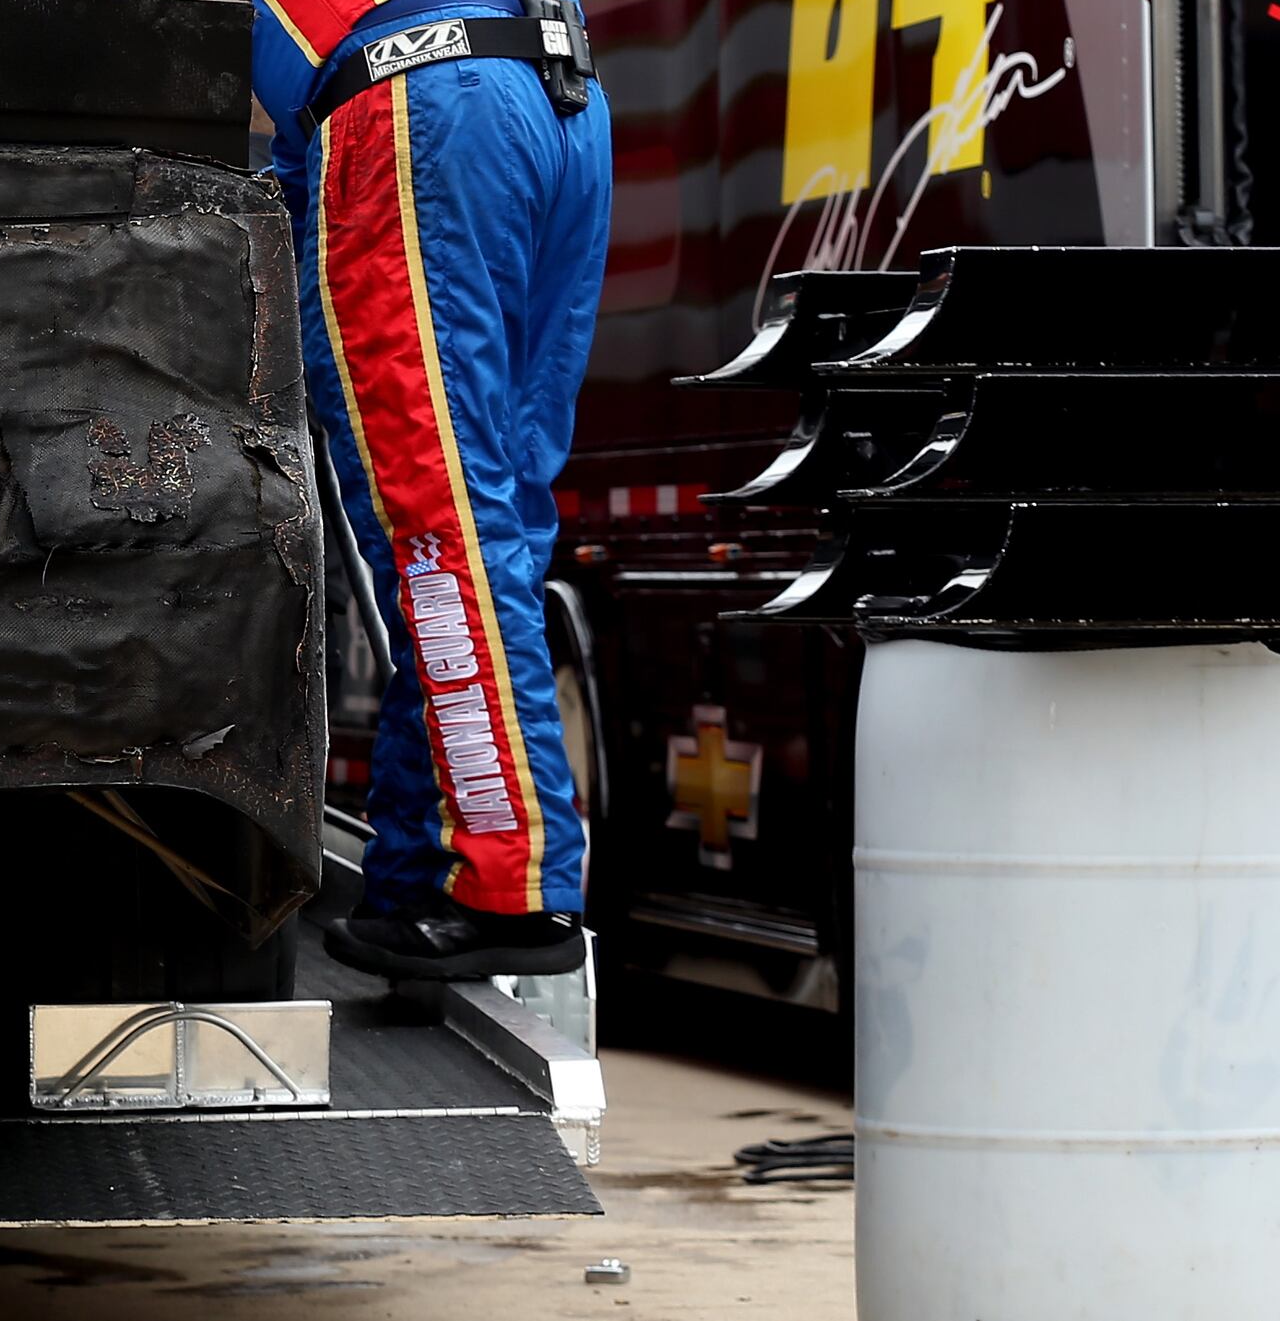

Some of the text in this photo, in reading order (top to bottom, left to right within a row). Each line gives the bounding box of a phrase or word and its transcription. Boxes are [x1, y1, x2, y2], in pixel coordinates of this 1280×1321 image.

[372, 42, 468, 79] MECHANIX WEAR
[410, 572, 519, 834] NATIONAL GUARD
